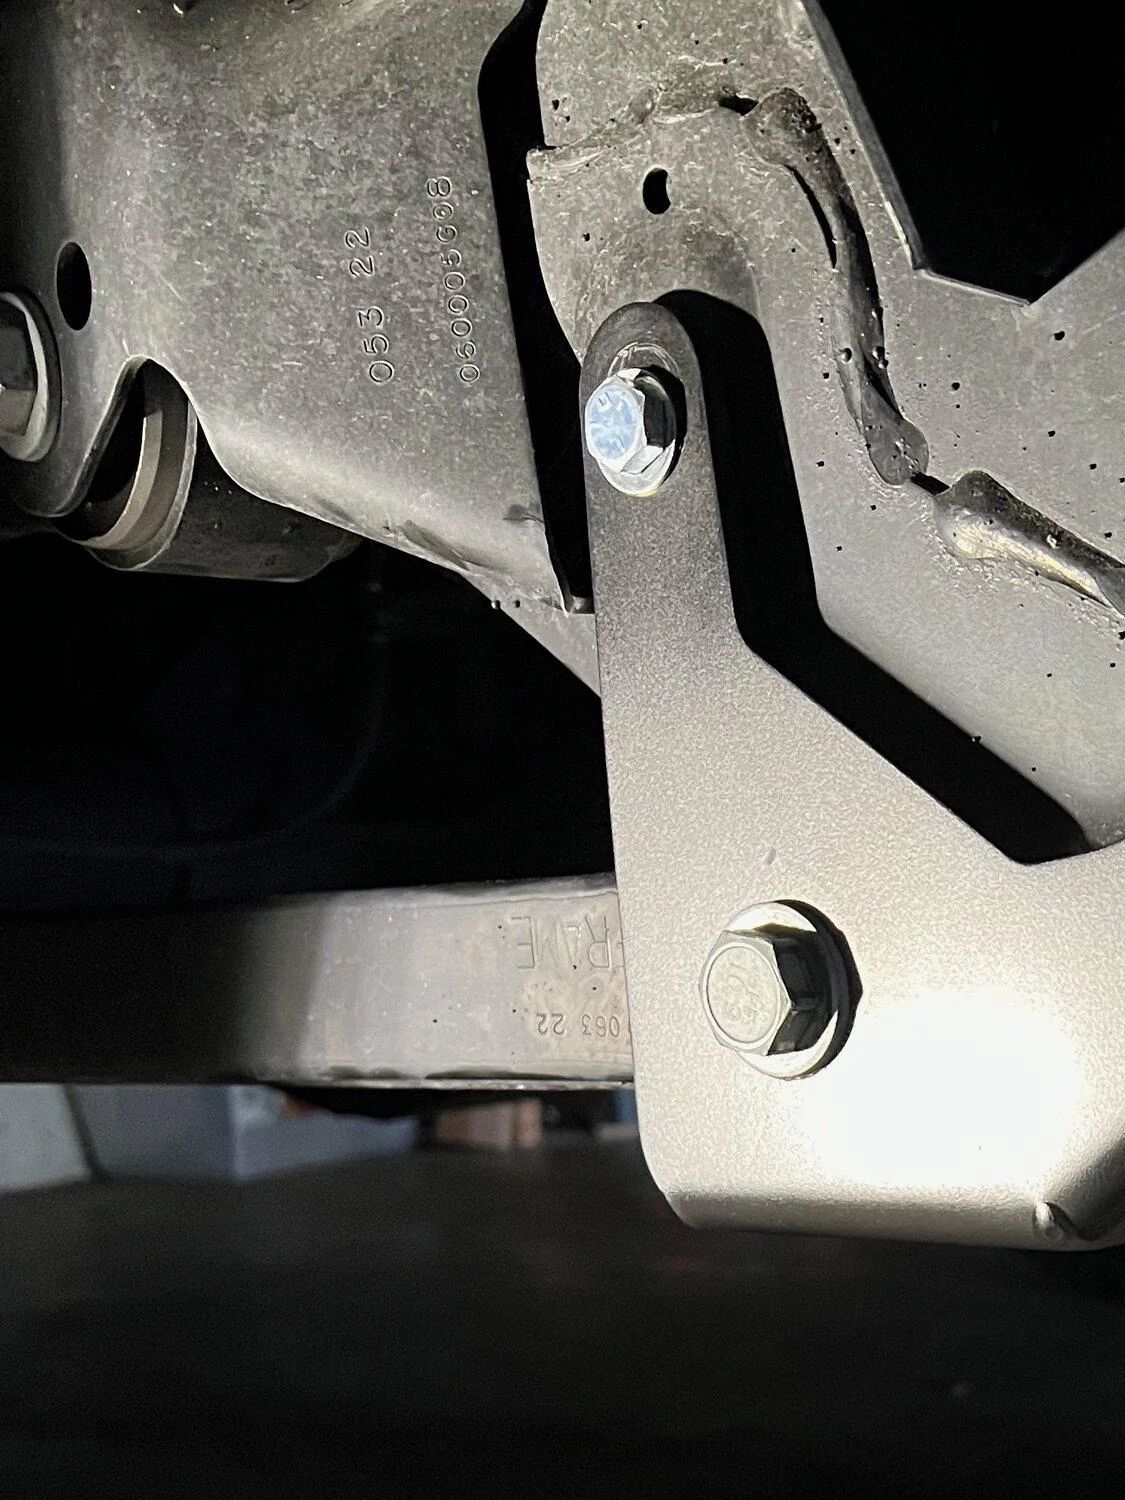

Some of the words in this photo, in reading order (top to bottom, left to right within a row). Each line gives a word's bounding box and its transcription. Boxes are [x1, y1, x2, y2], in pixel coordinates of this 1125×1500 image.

[345, 226, 375, 278] 22
[357, 304, 394, 384] 053
[535, 1012, 566, 1036] 22
[581, 1013, 620, 1038] 063
